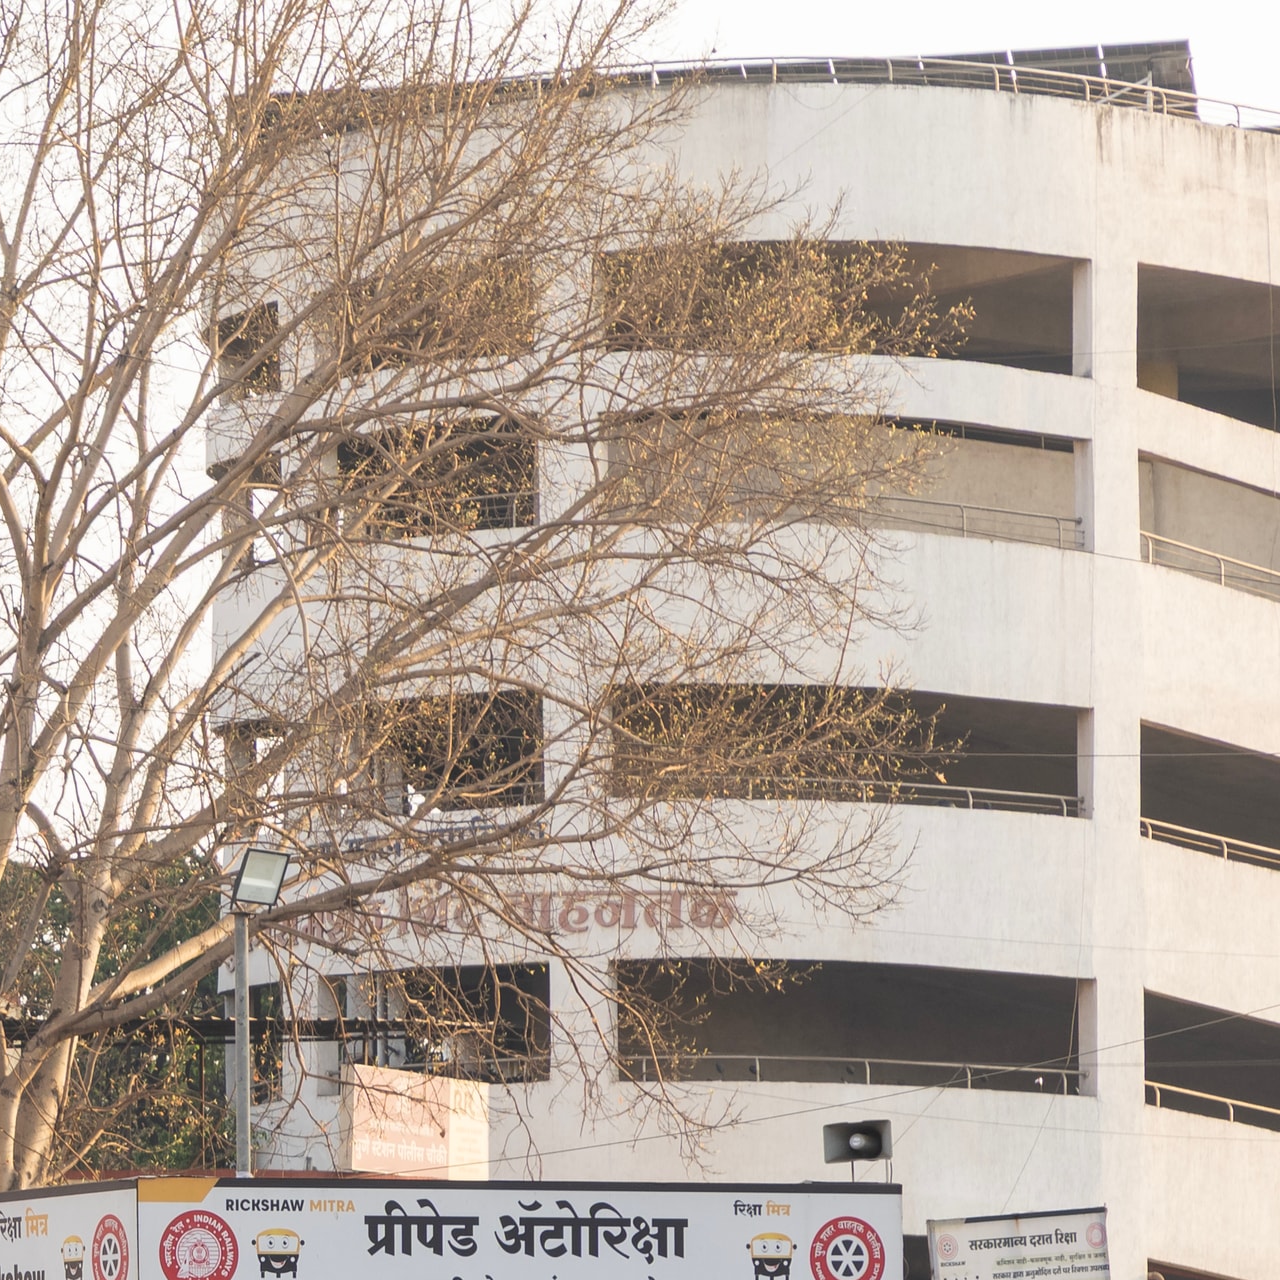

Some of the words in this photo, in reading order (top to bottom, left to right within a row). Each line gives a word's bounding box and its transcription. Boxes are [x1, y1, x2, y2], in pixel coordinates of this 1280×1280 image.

[225, 1199, 304, 1212] RICKSHAW
[309, 1200, 356, 1213] MITRA
[733, 1199, 762, 1218] रिक्षा
[766, 1200, 791, 1216] मित्र
[25, 1207, 48, 1238] मित्र
[364, 1199, 480, 1257] प्रीपेड
[193, 1214, 223, 1232] INDIAN
[221, 1230, 235, 1278] RAILWAYS
[1029, 1234, 1052, 1248] दरात
[1055, 1228, 1077, 1245] रिक्षा
